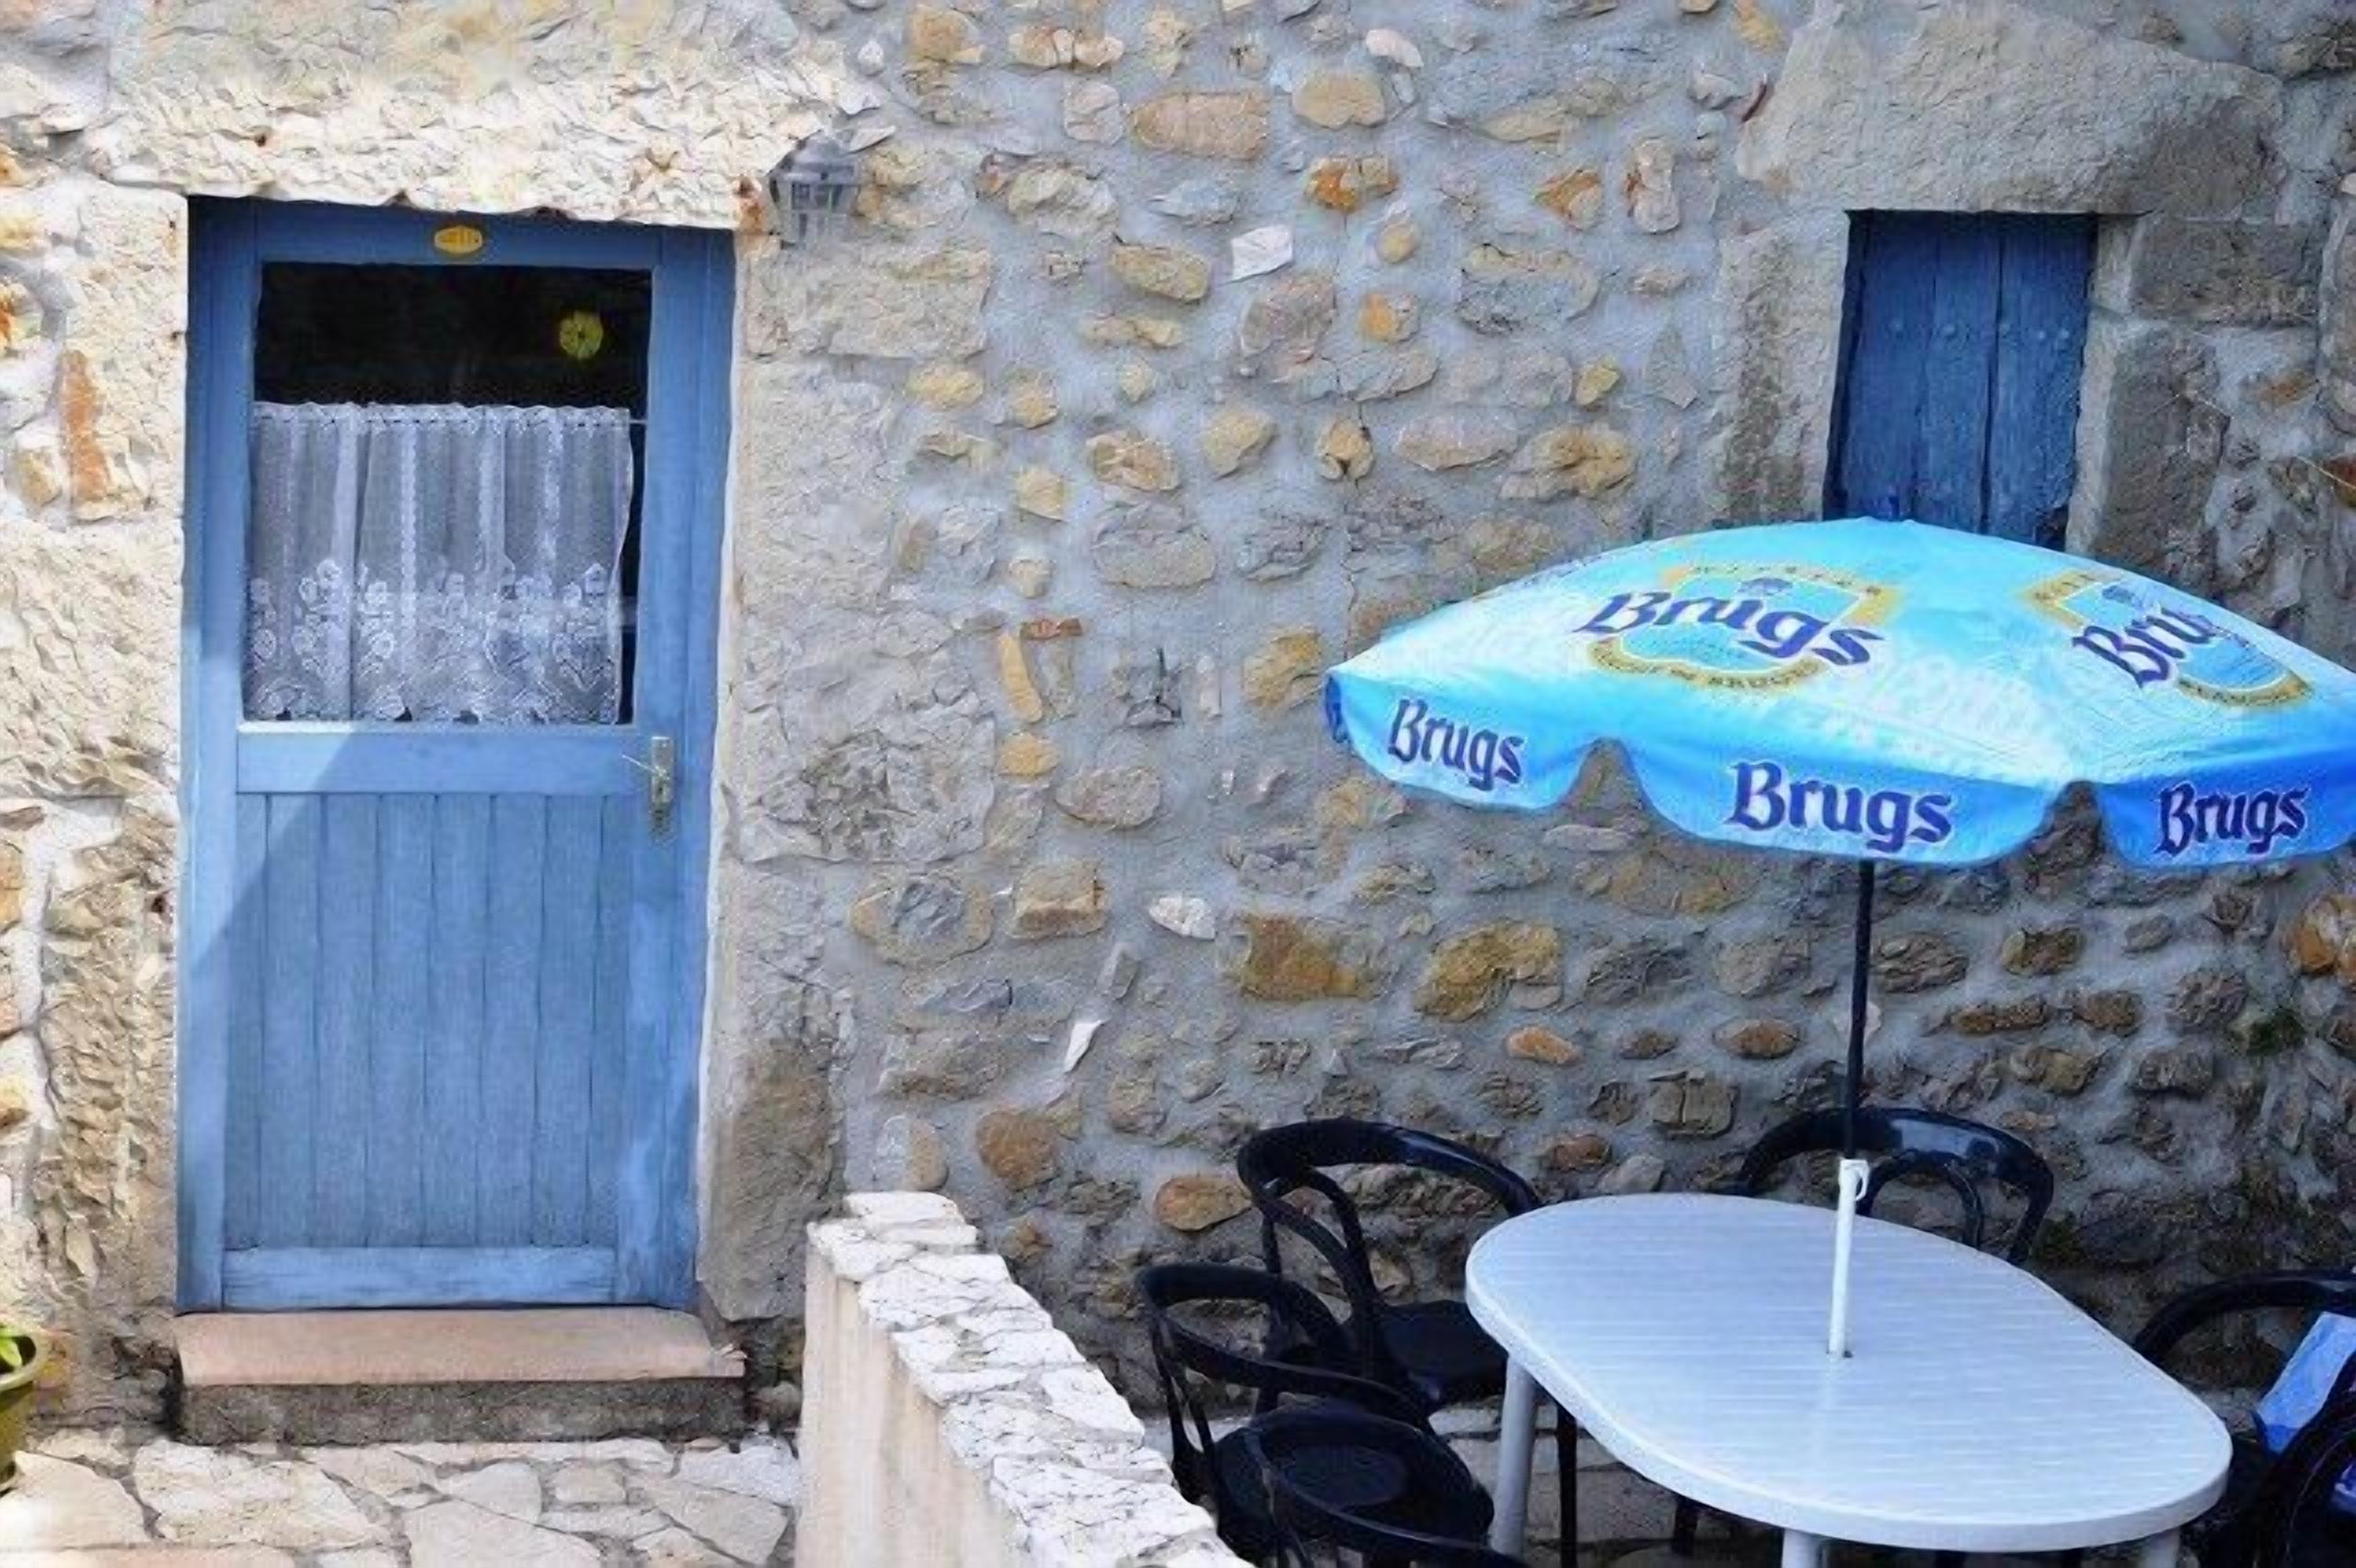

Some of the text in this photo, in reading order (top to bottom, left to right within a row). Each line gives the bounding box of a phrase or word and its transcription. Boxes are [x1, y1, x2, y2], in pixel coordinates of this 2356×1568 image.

[1572, 592, 1884, 665] Brugs
[2073, 607, 2246, 689] Bru
[1388, 699, 1524, 791] Brugs
[1724, 762, 1951, 853] Brugs
[2154, 783, 2309, 857] Brugs
